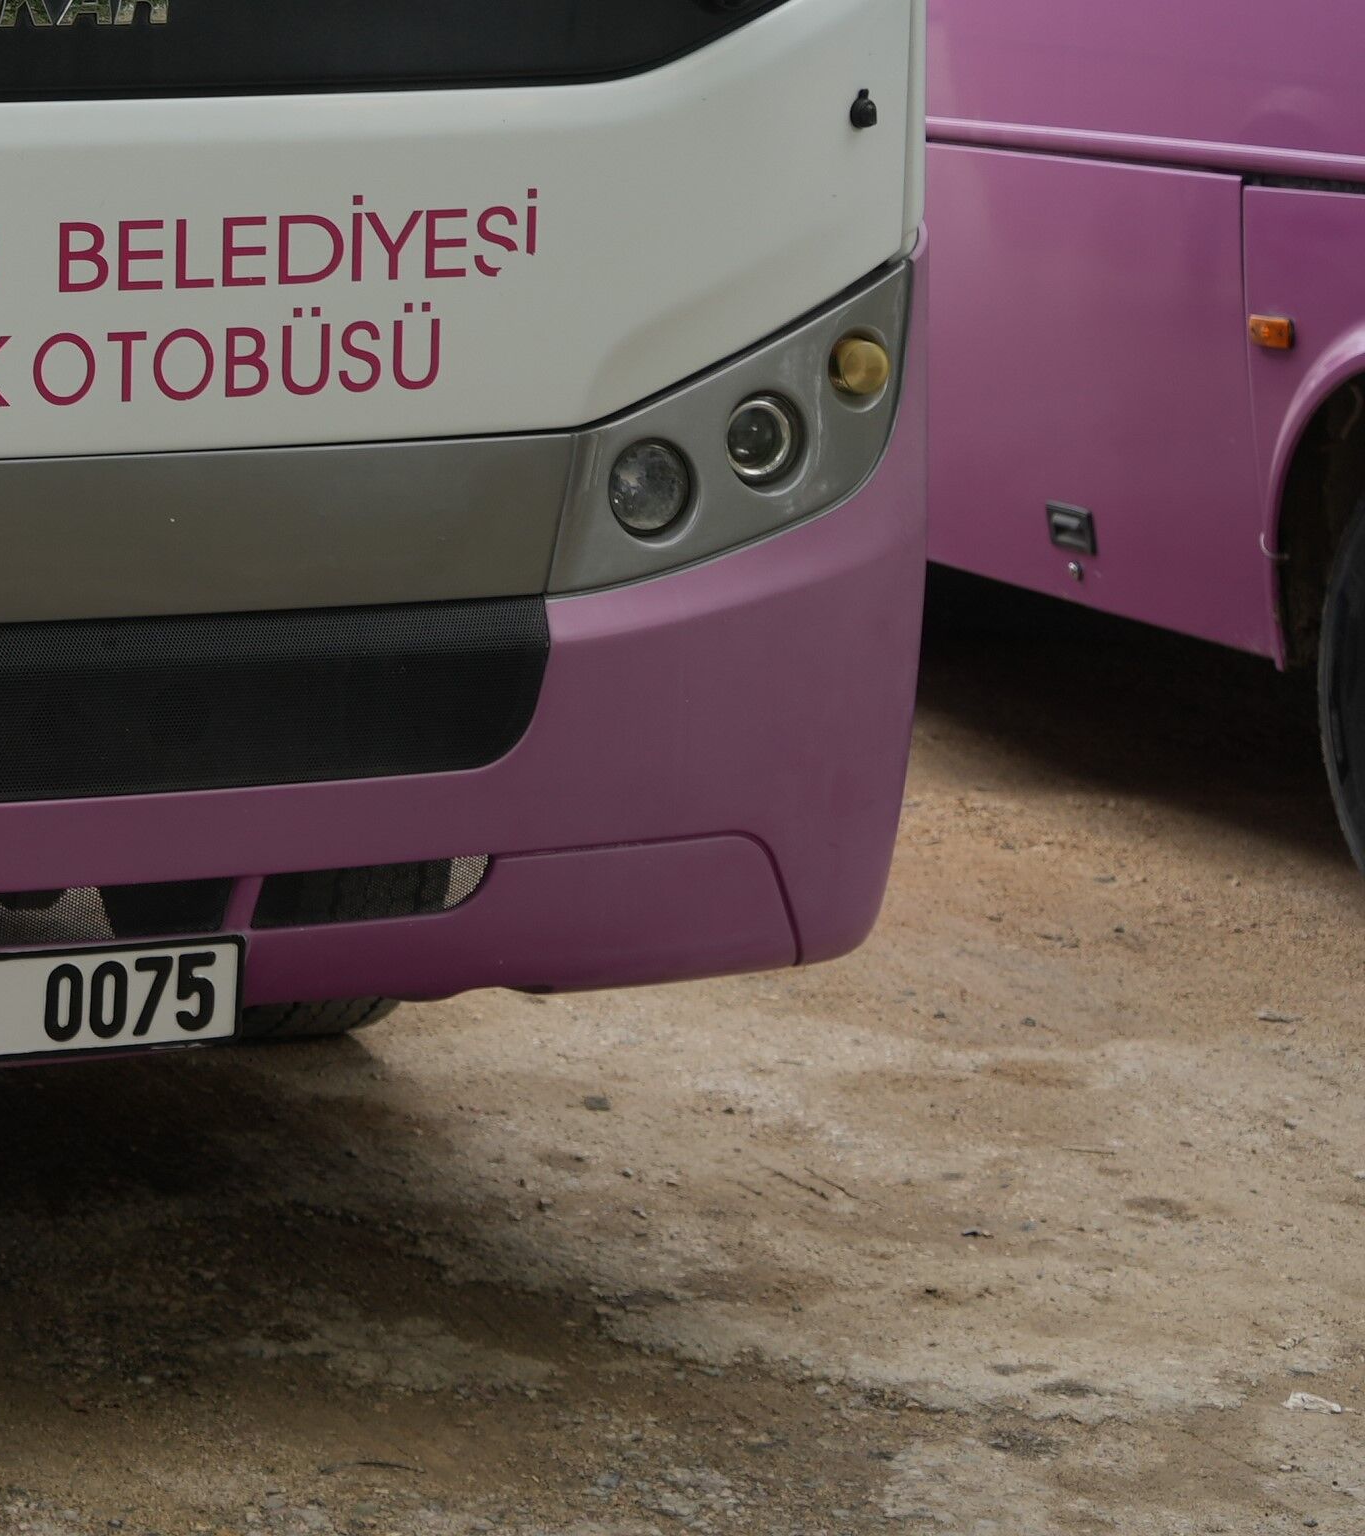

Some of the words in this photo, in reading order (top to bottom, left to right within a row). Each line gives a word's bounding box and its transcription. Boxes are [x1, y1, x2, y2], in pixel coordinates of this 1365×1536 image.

[58, 188, 539, 293] BELEDİYESİ
[32, 301, 441, 406] OTOBÜSÜ
[44, 951, 217, 1043] 0075
